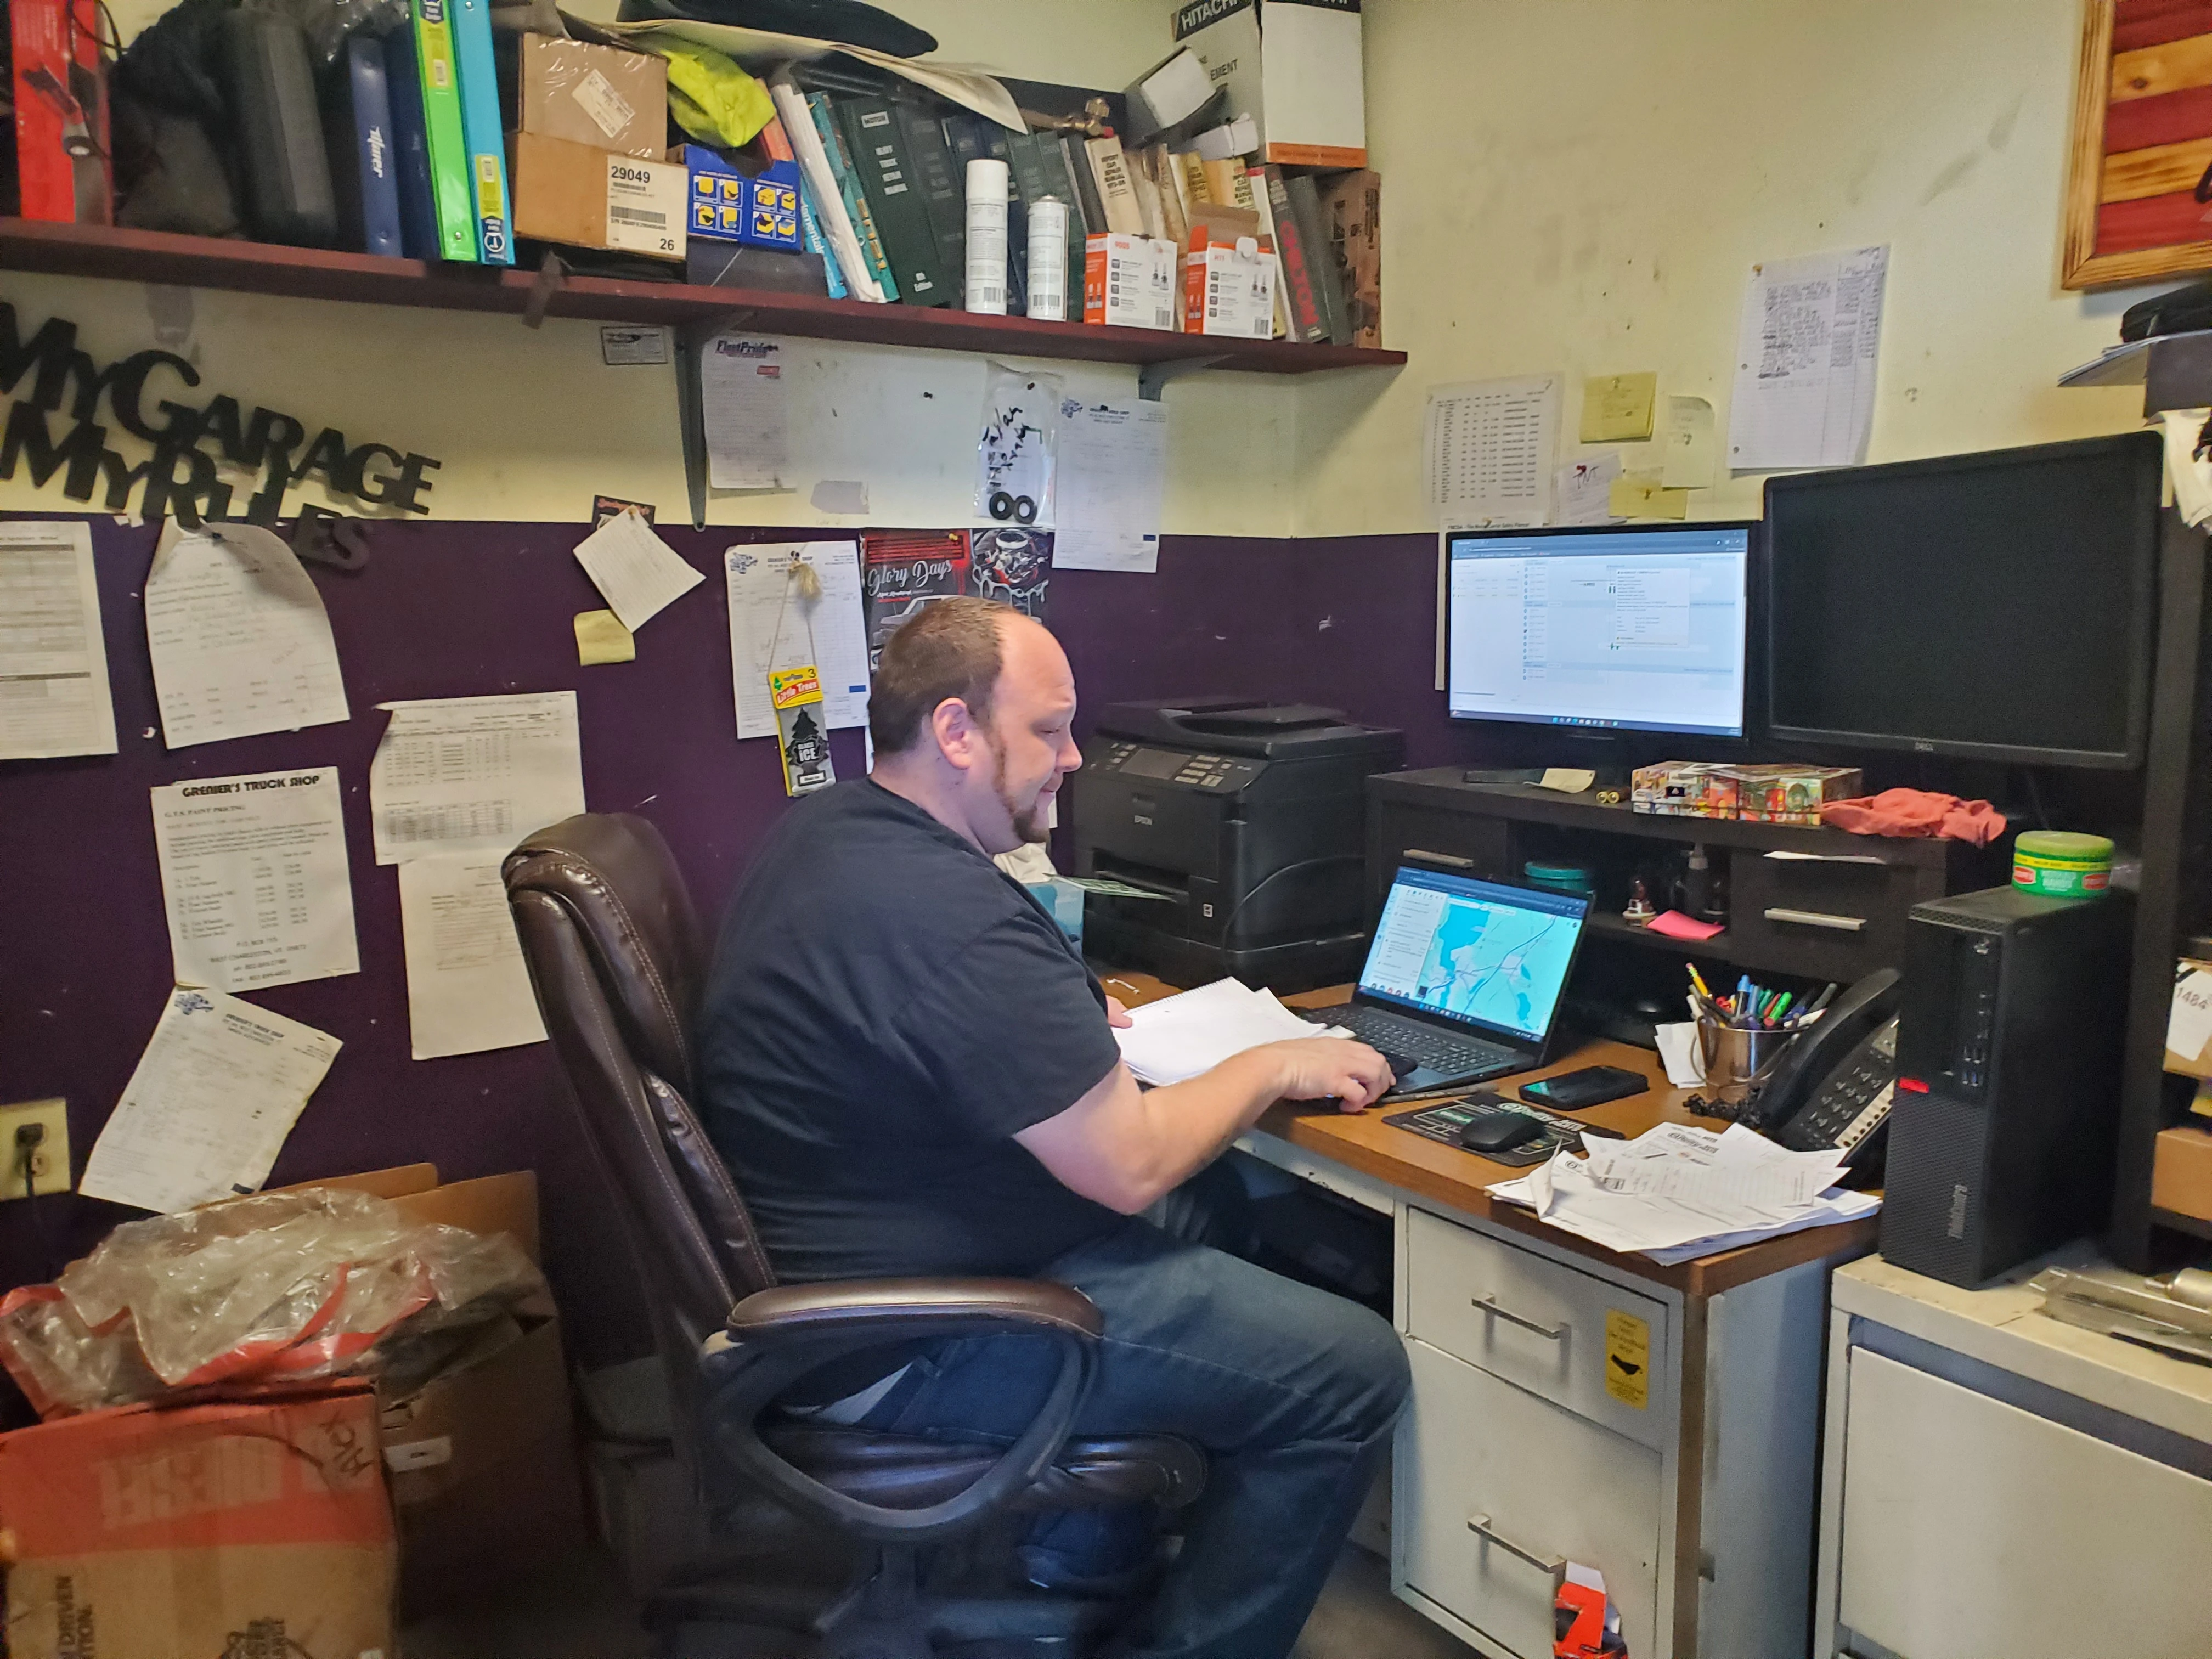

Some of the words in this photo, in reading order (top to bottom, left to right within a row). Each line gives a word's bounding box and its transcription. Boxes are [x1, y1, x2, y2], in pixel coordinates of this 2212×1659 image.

[1181, 0, 1237, 31] HITACH
[611, 166, 650, 183] 29049
[660, 238, 674, 251] 26
[111, 349, 441, 515] GARAGE
[141, 440, 375, 571] RES
[867, 565, 909, 596] Glory
[912, 560, 952, 588] Days
[808, 668, 816, 678] 3
[777, 687, 797, 704] Little
[797, 681, 817, 693] Trees
[182, 783, 240, 797] GRENIER'S
[244, 778, 286, 791] TRUCK
[290, 775, 320, 787] SHOP
